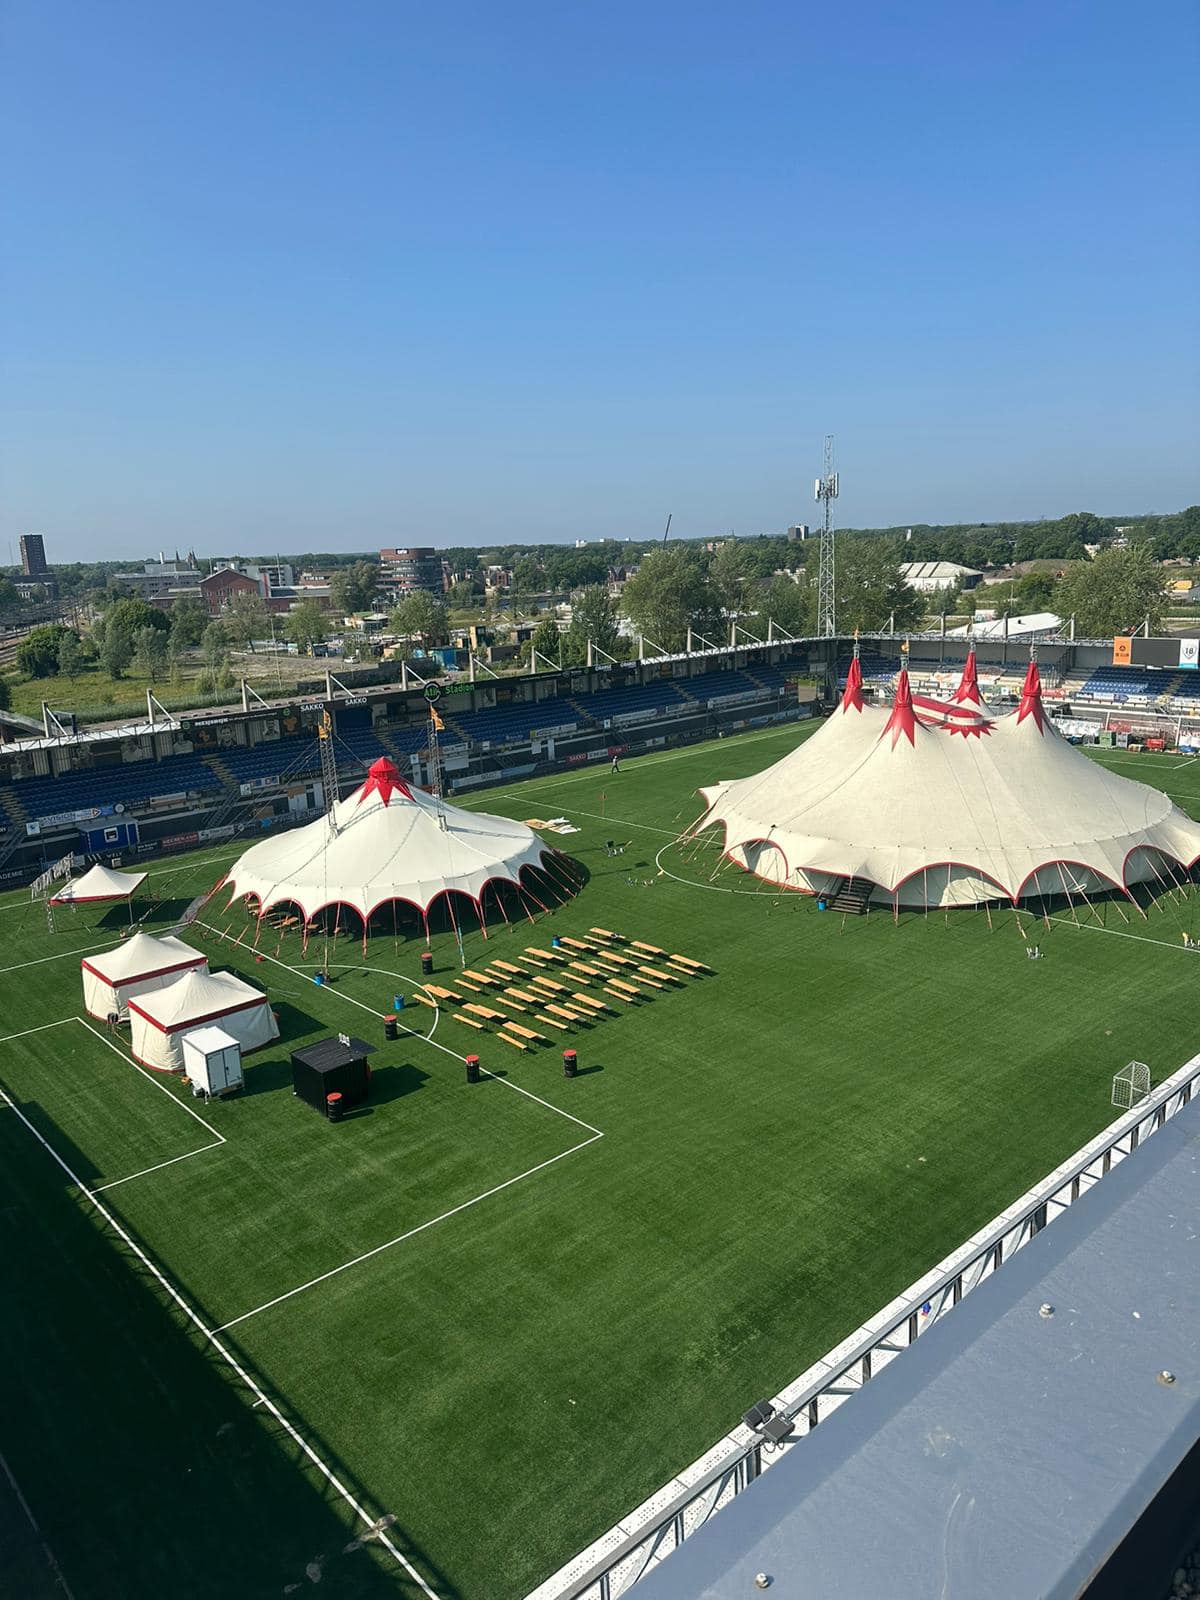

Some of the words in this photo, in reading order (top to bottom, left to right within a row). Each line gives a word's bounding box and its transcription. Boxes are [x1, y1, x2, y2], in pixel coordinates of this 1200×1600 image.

[1185, 647, 1194, 655] 18
[445, 684, 475, 694] Stadion
[345, 697, 367, 706] SAKKO
[300, 703, 324, 712] SAKKO
